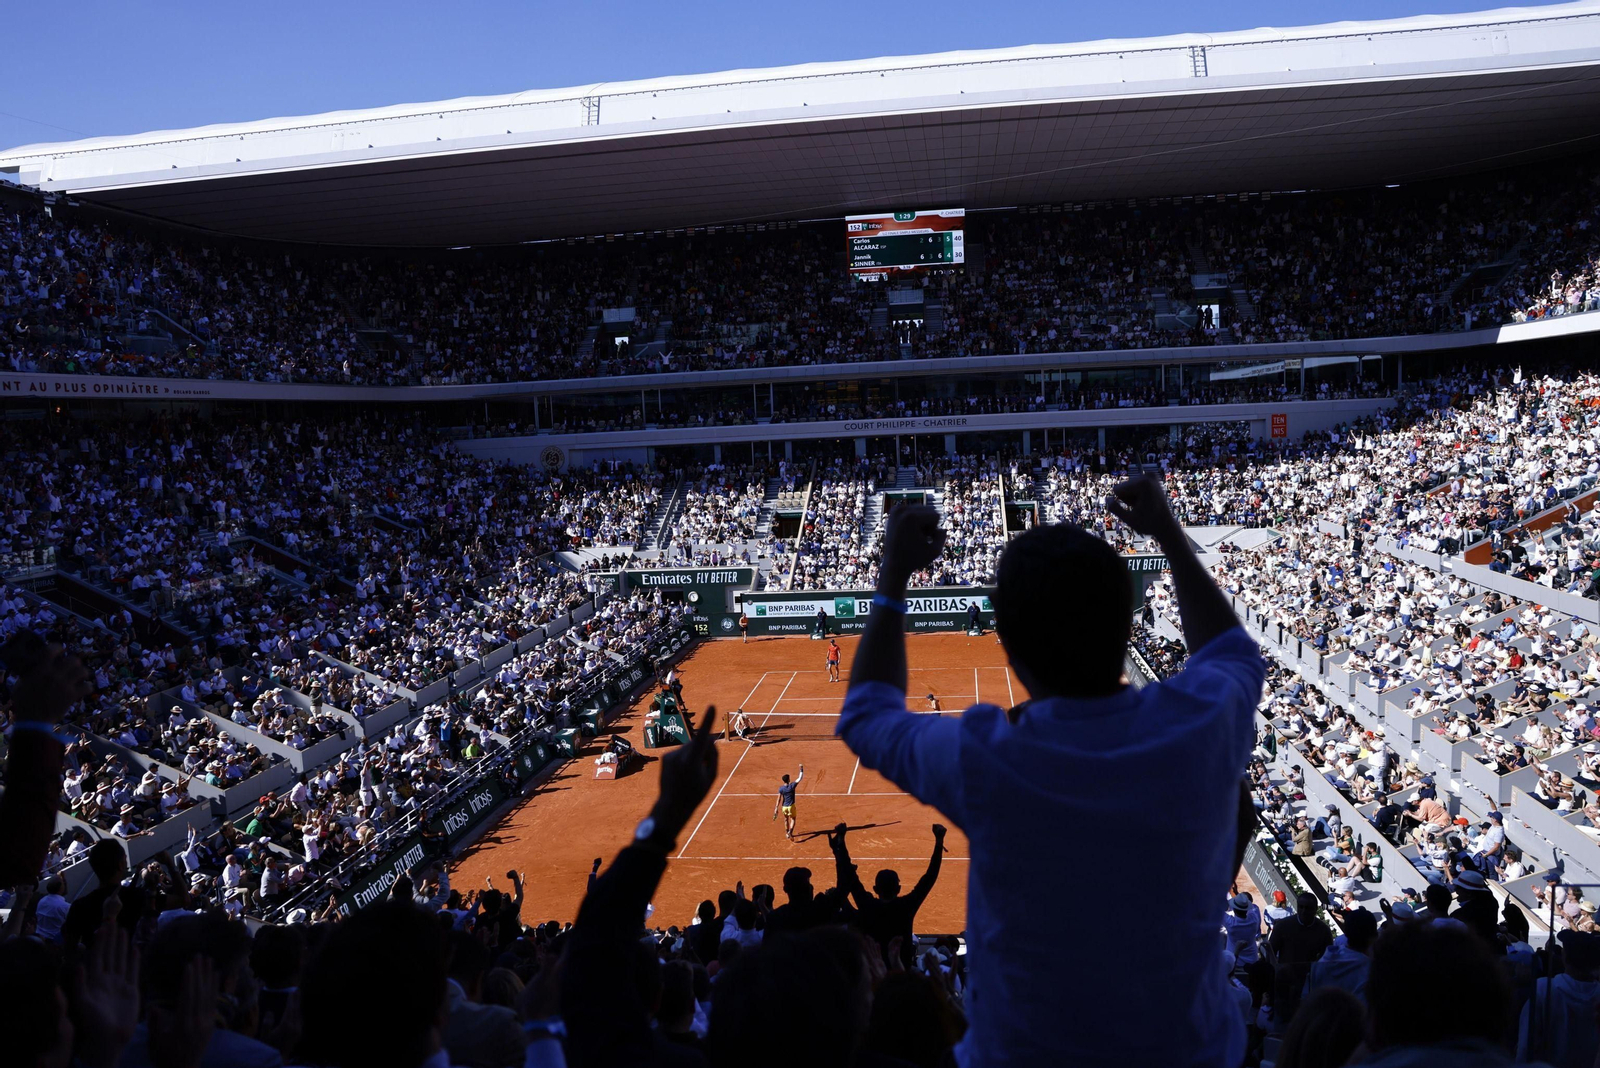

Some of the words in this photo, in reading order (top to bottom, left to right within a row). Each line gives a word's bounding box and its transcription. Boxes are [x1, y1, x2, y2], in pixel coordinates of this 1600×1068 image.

[2, 381, 21, 391] NT
[29, 382, 47, 392] AU
[55, 382, 87, 393] PLUS
[93, 381, 159, 394] OPINIÂTRE
[844, 422, 875, 431] COURT
[876, 420, 916, 429] PHILIPPE
[923, 418, 967, 427] CHATRIER
[1273, 416, 1285, 424] TEN
[1127, 559, 1141, 571] FLY
[27, 578, 56, 590] PARIBAS
[641, 573, 692, 585] Emirates
[696, 572, 710, 584] FLY
[710, 571, 738, 584] BETTER
[785, 604, 815, 612] PARIBAS
[905, 598, 968, 612] PARIBAS
[442, 807, 469, 836] Infosys
[468, 788, 493, 814] Infosys
[353, 869, 396, 910] Emirates
[403, 843, 425, 870] BETTER
[1254, 858, 1279, 899] Emirate
